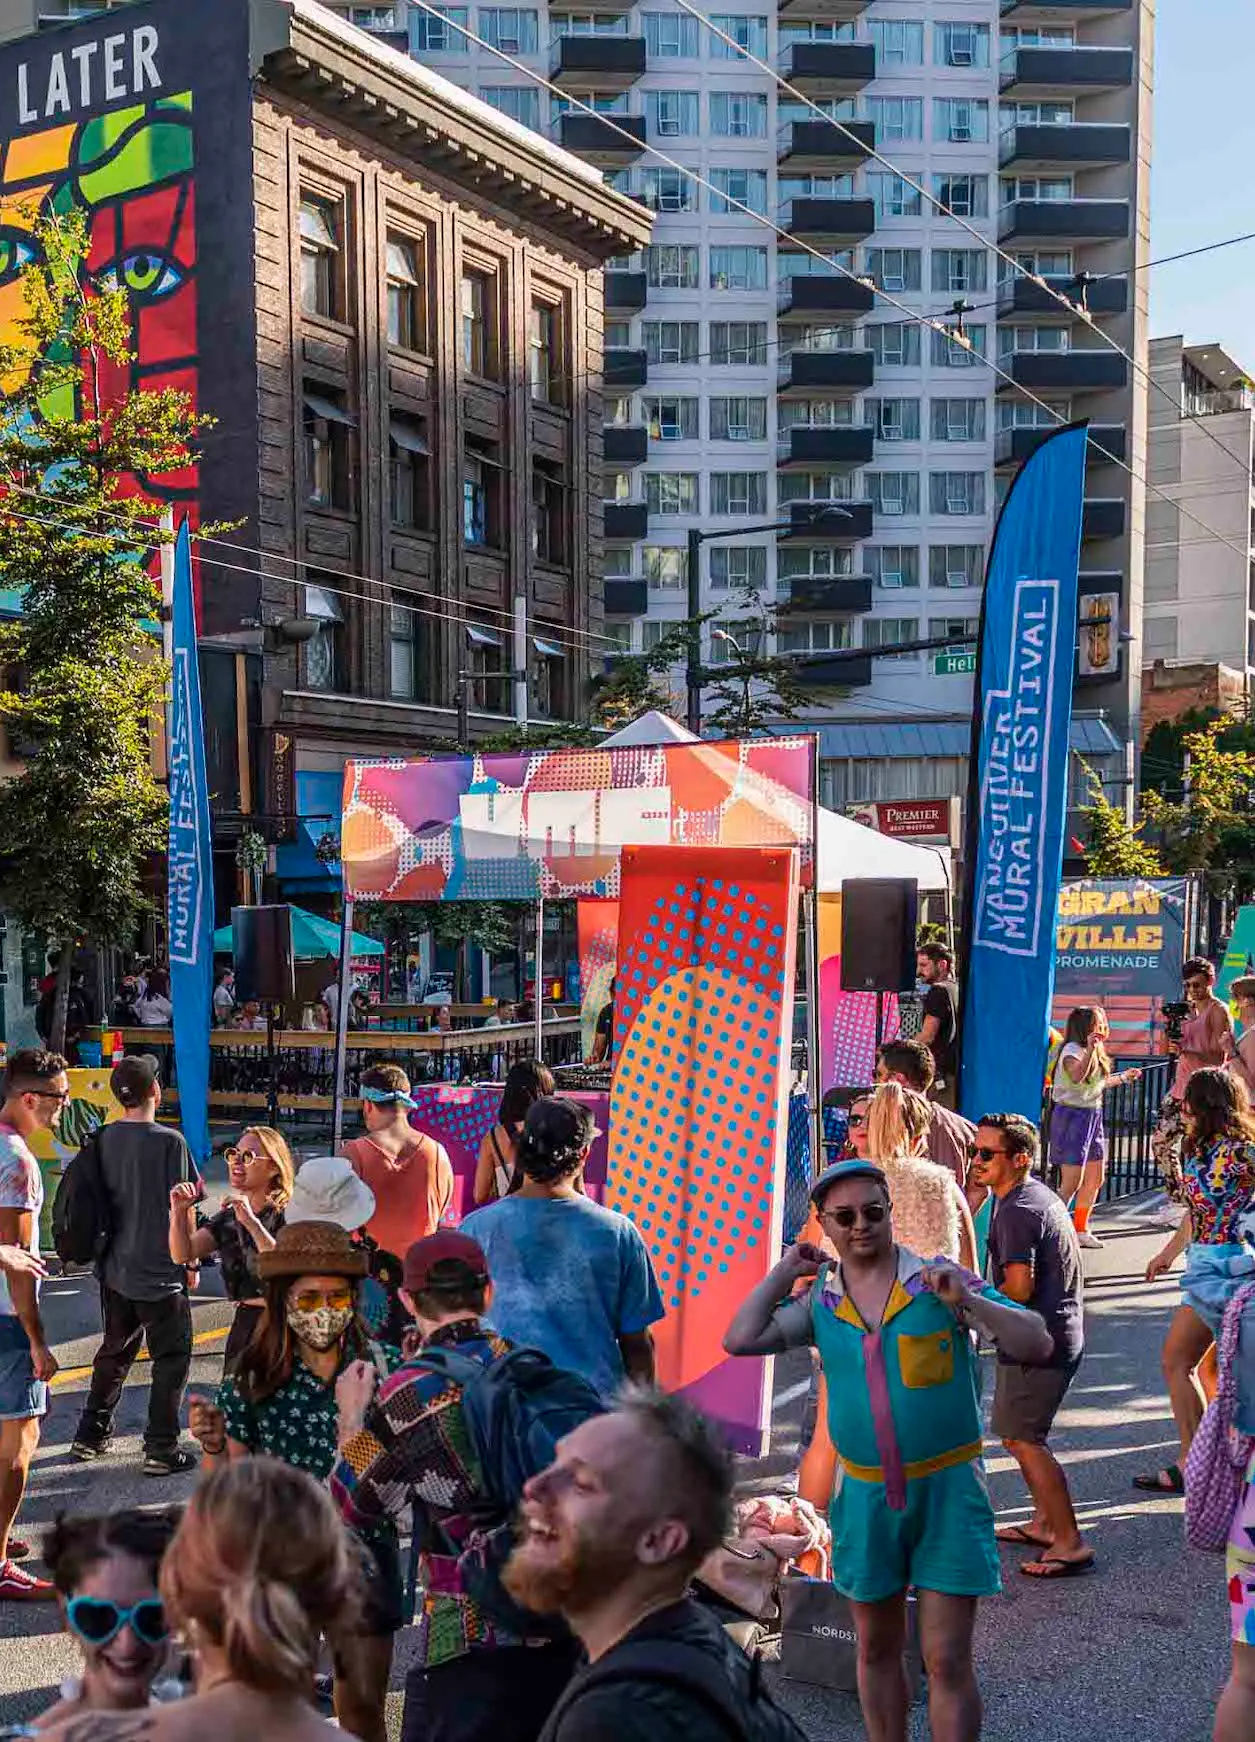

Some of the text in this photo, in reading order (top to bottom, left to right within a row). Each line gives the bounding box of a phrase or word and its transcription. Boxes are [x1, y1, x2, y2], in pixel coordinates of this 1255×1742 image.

[17, 25, 163, 125] LATER
[947, 656, 977, 672] Hel
[176, 662, 194, 829] FEST
[1004, 597, 1047, 939] MURAL FESTIVAL
[885, 808, 941, 823] PREMIER
[1058, 891, 1161, 916] GRAN
[1056, 924, 1163, 951] VILLE
